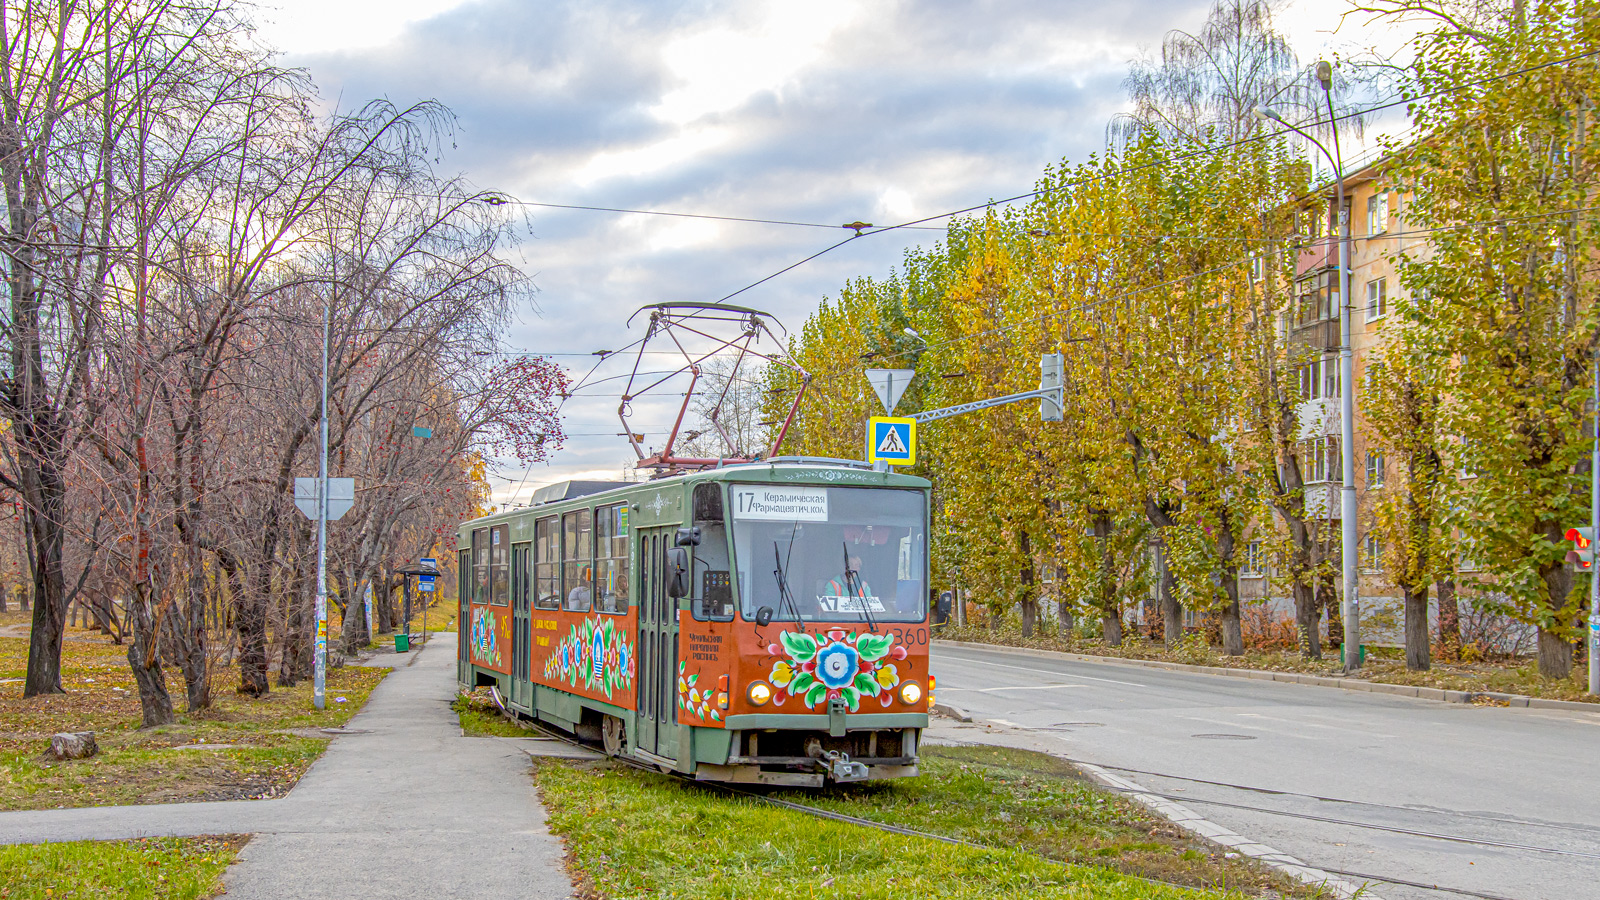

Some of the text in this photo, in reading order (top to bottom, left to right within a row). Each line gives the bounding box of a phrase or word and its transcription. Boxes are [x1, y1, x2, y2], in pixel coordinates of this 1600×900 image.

[738, 492, 755, 513] 17
[764, 492, 825, 504] Керамическая
[820, 597, 839, 611] 17
[893, 628, 927, 645] 360
